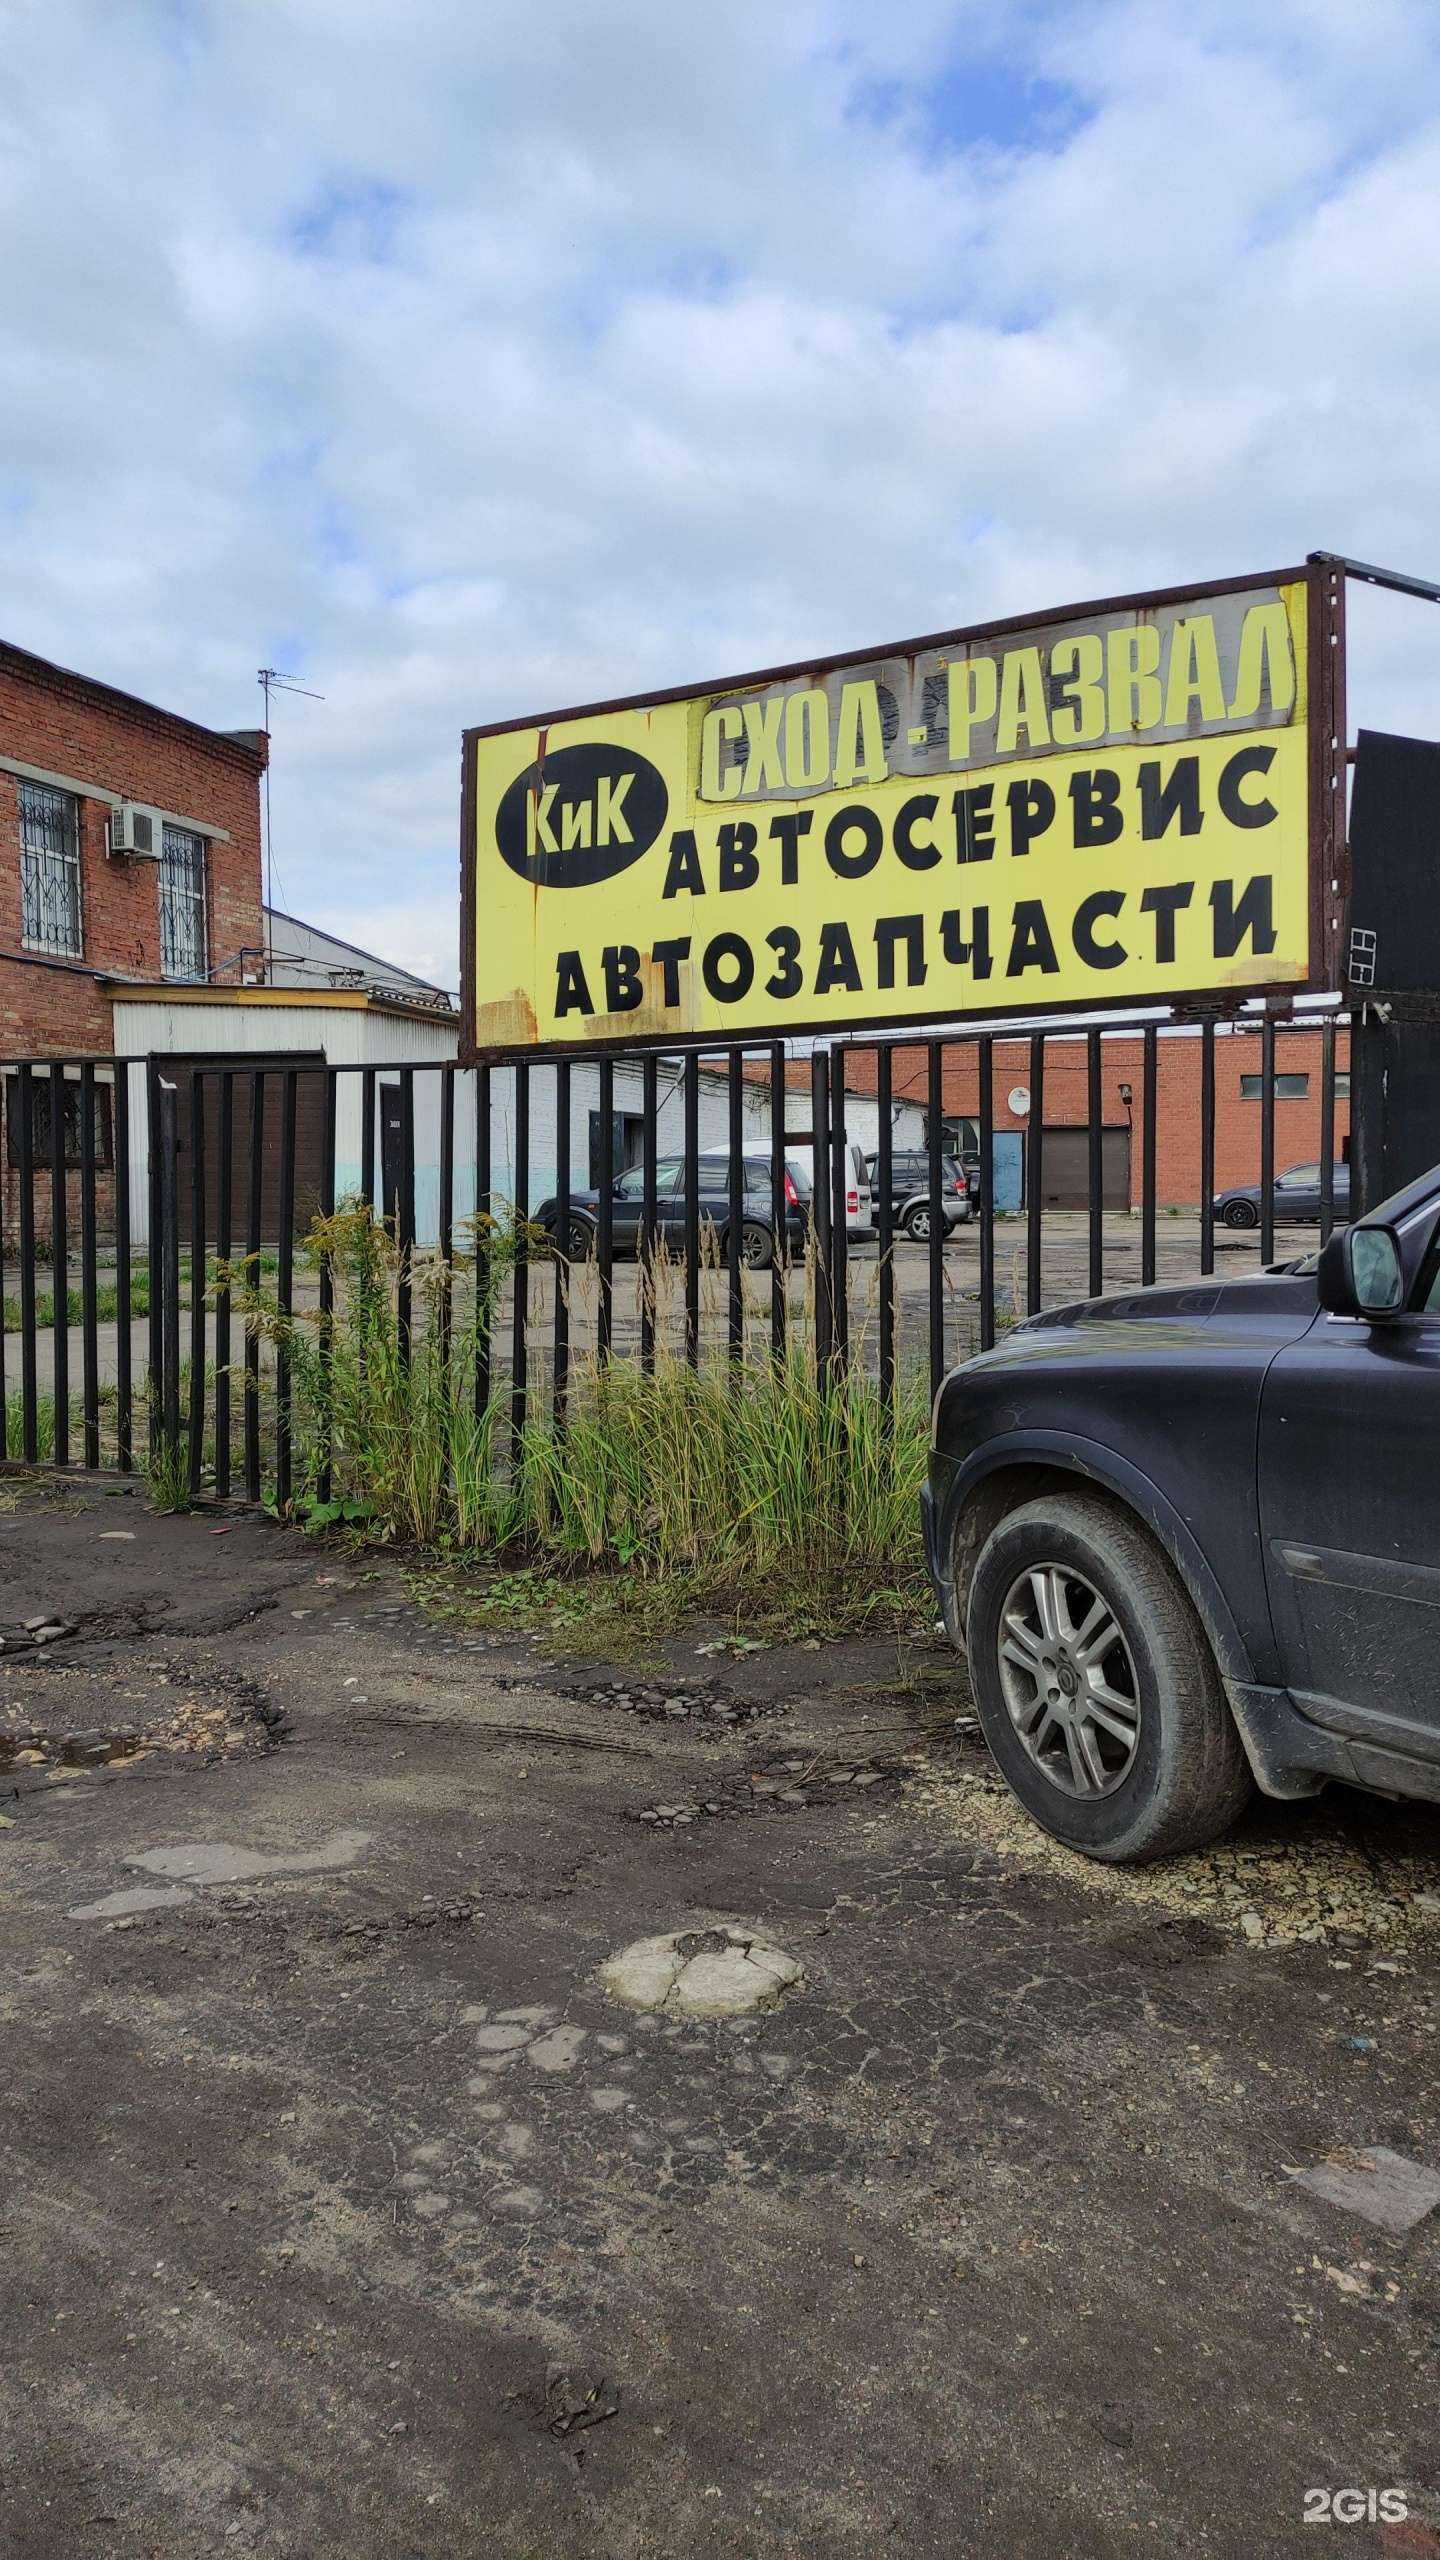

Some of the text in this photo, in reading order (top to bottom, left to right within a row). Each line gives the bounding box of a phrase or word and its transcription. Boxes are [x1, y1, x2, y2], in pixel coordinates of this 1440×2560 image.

[702, 680, 888, 801] СХОД
[948, 602, 1294, 761] РАЗВАЛ
[526, 774, 634, 856] КиК
[662, 746, 1279, 899] АВТОСЕРВИС
[554, 875, 1278, 1018] АВТОЗАПЧАСТИ
